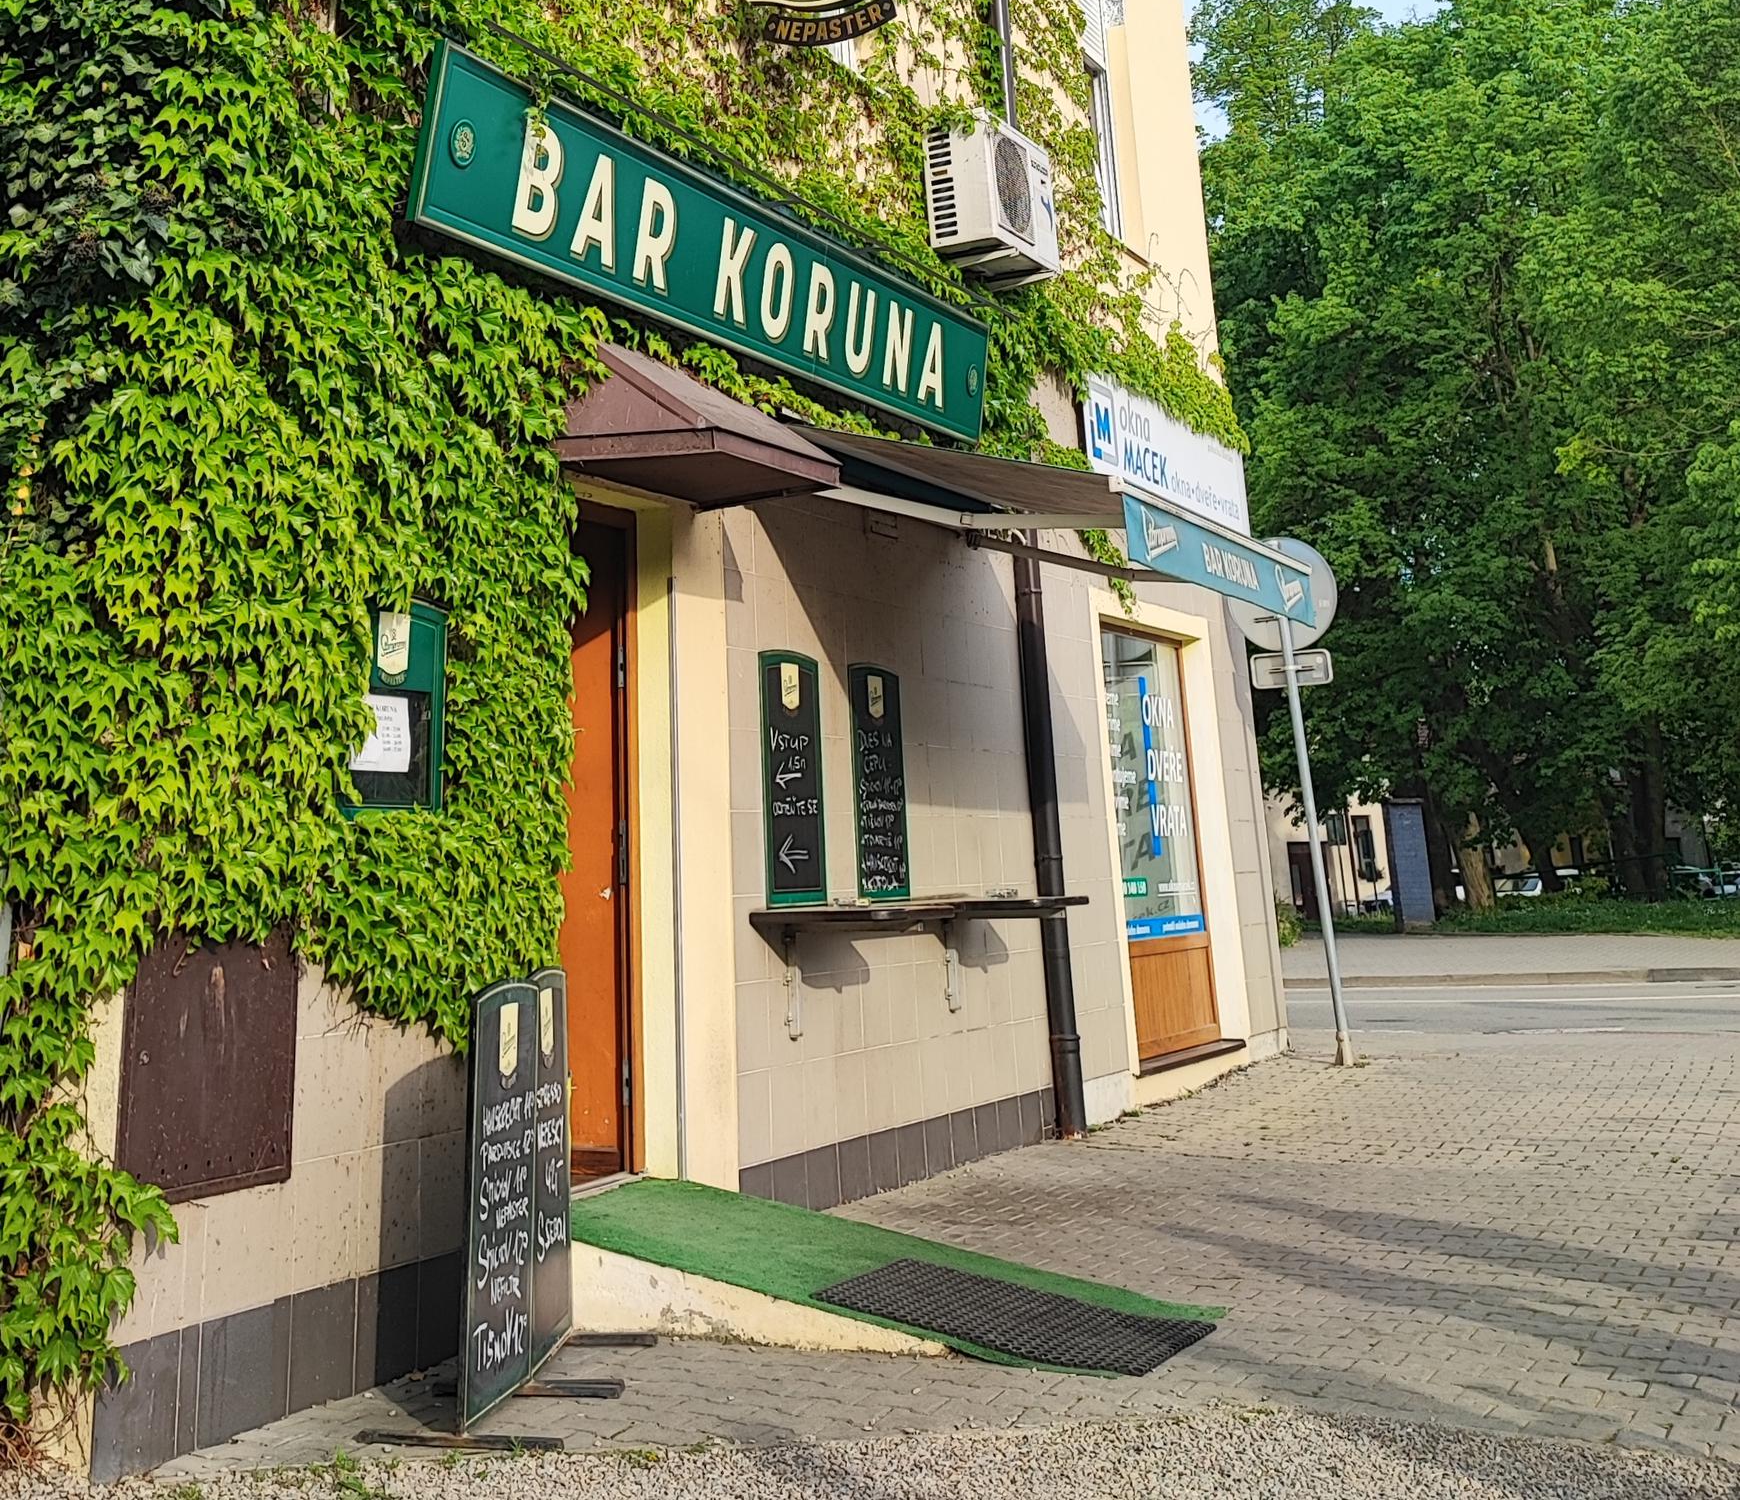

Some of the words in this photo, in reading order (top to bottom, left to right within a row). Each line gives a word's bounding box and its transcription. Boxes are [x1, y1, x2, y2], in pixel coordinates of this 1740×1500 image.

[774, 2, 886, 42] NEPASTER
[511, 117, 677, 296] BAR
[713, 216, 946, 412] KORUNA
[1119, 399, 1151, 442] okna
[1124, 437, 1169, 490] MACEK
[1201, 541, 1225, 578] BAR
[1221, 550, 1260, 591] KORUNA
[1142, 694, 1175, 728] OKNA
[770, 727, 809, 751] VSTUP
[1147, 746, 1184, 782] DVEŘE
[1151, 804, 1188, 837] VRATA
